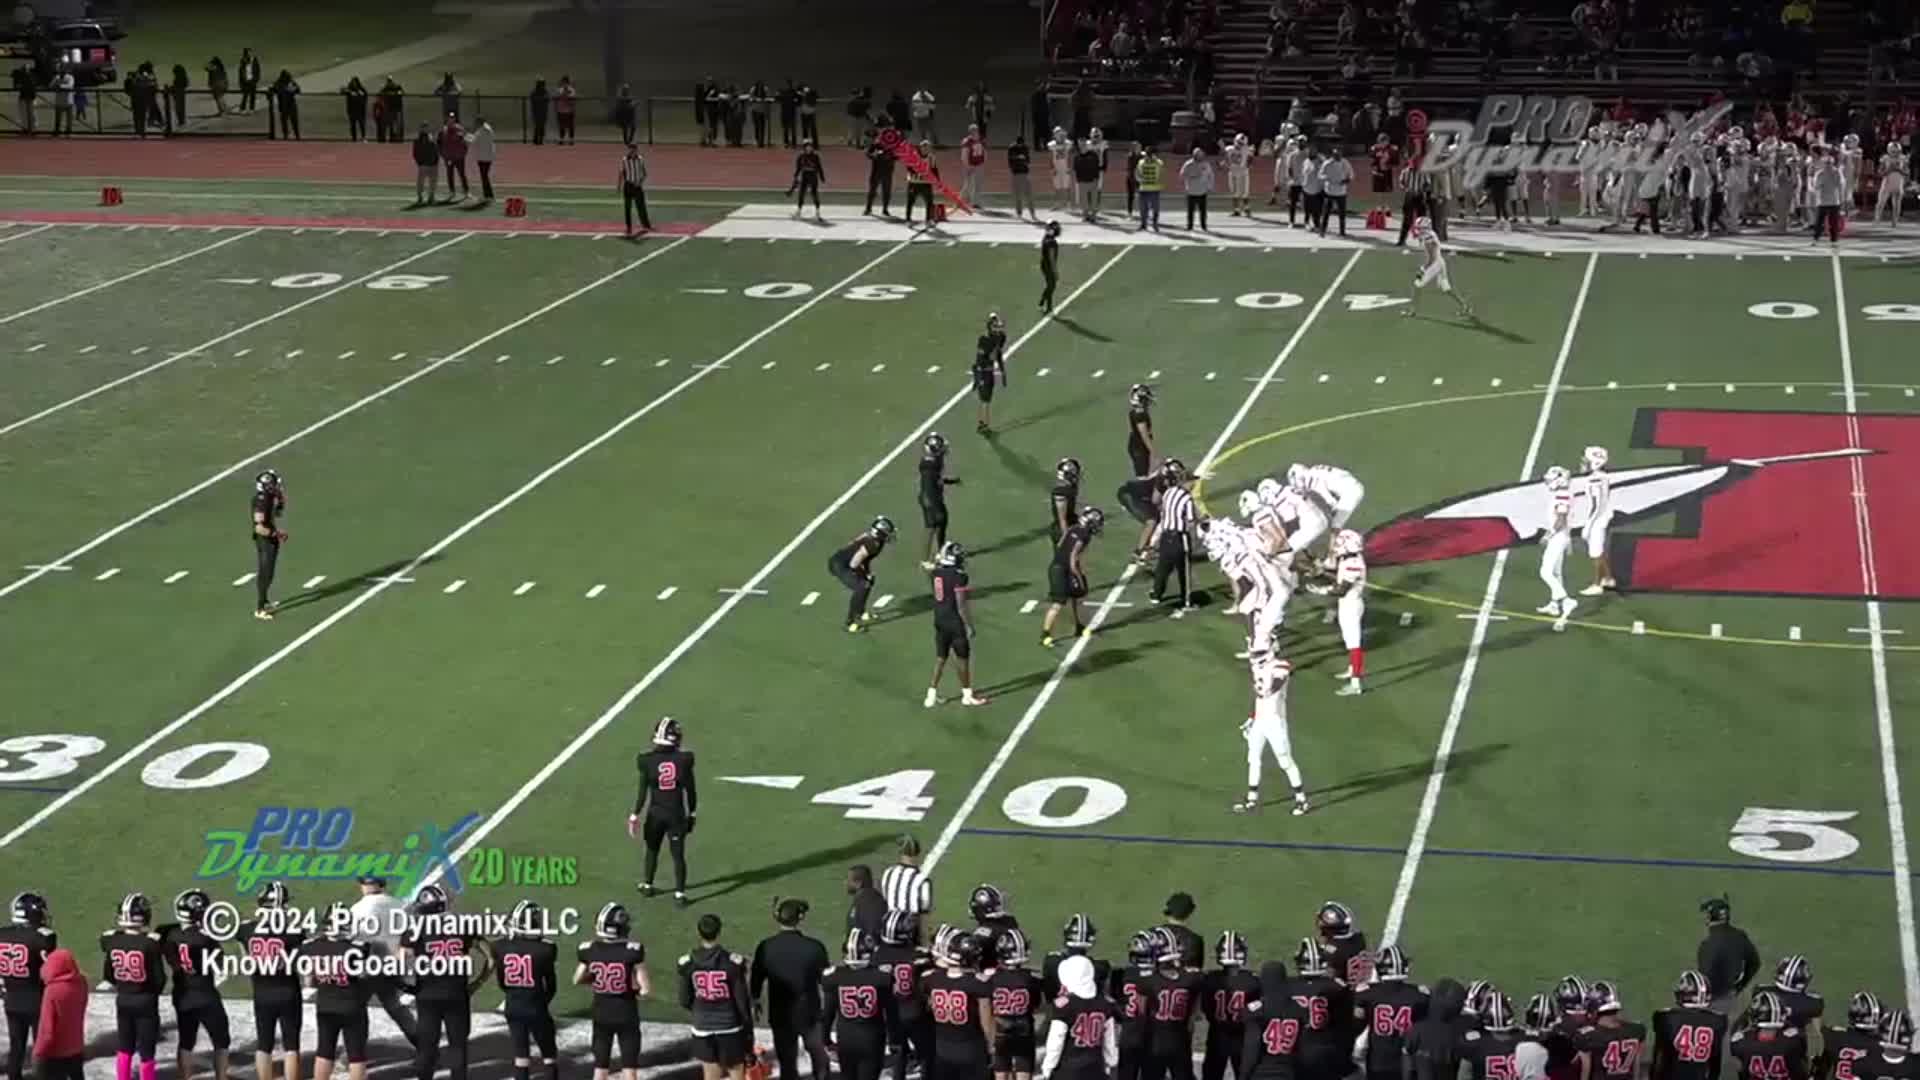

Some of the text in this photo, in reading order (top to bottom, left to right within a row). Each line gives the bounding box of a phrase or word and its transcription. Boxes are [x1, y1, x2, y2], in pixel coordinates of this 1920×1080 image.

[657, 761, 677, 790] 2
[111, 949, 147, 983] 29
[503, 953, 535, 987] 21
[590, 962, 627, 994] 32
[839, 985, 877, 1018] 53
[931, 989, 968, 1025] 88
[992, 988, 1030, 1016] 22
[1214, 989, 1245, 1021] 14
[1070, 1011, 1106, 1048] 40
[1263, 1017, 1299, 1055] 49
[1374, 1004, 1414, 1037] 64
[1602, 1038, 1640, 1074] 47
[1673, 1024, 1714, 1063] 48
